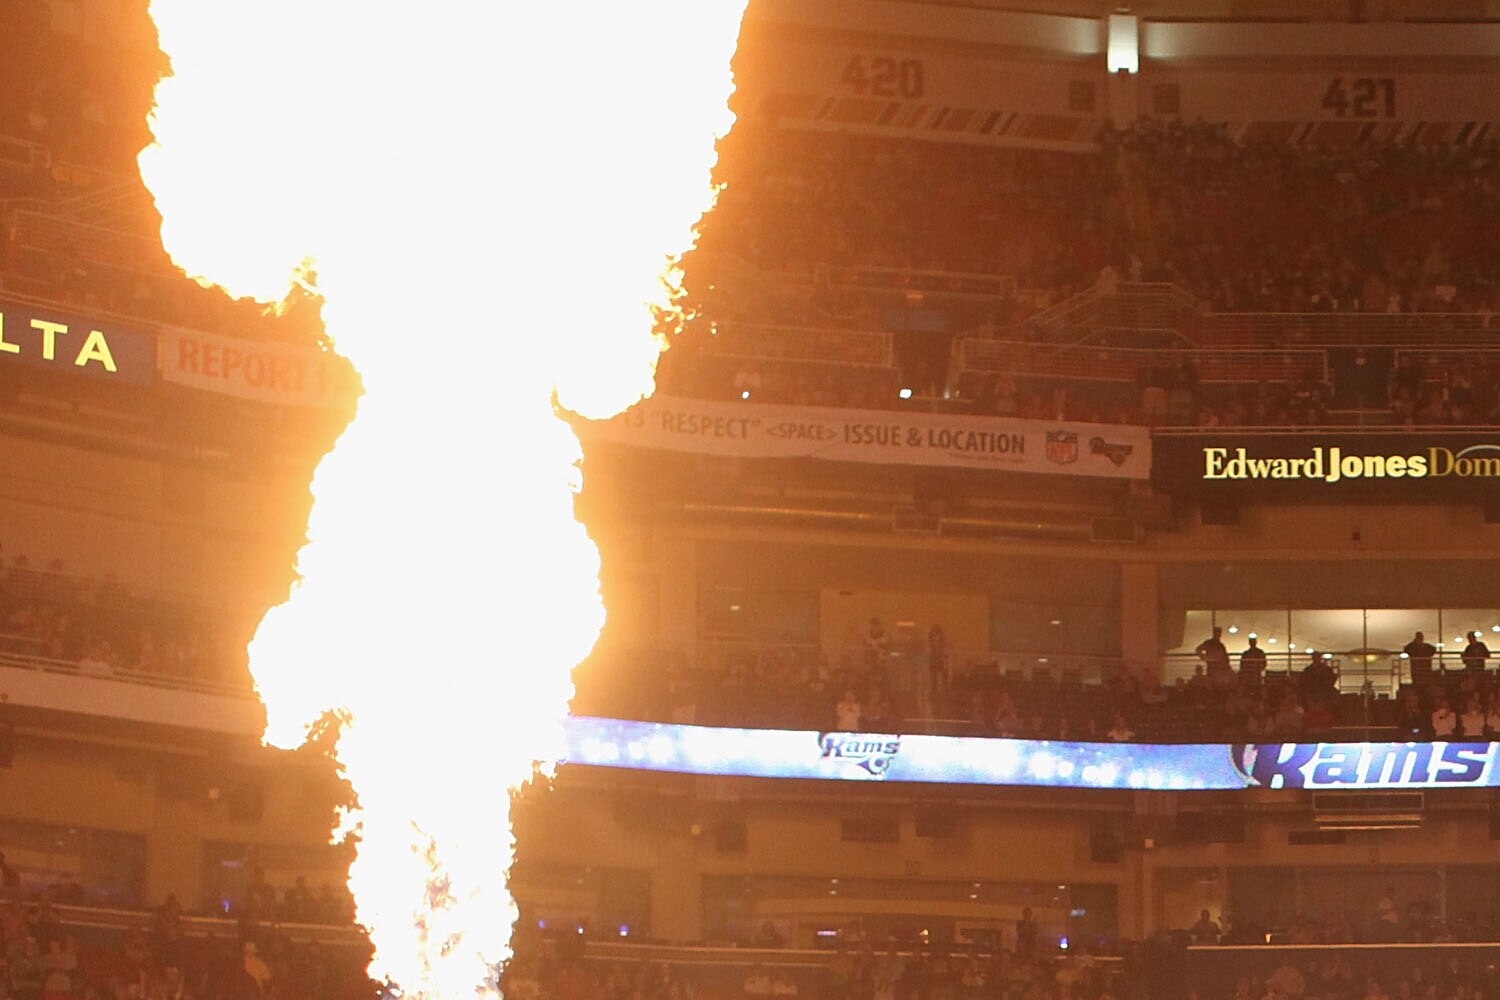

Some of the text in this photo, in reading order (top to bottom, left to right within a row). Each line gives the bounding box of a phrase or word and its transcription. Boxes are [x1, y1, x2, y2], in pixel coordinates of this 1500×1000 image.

[841, 55, 923, 98] 420
[1322, 77, 1396, 117] 421
[844, 423, 899, 446] ISSUE
[905, 427, 922, 447] &
[927, 428, 1026, 455] LOCATION
